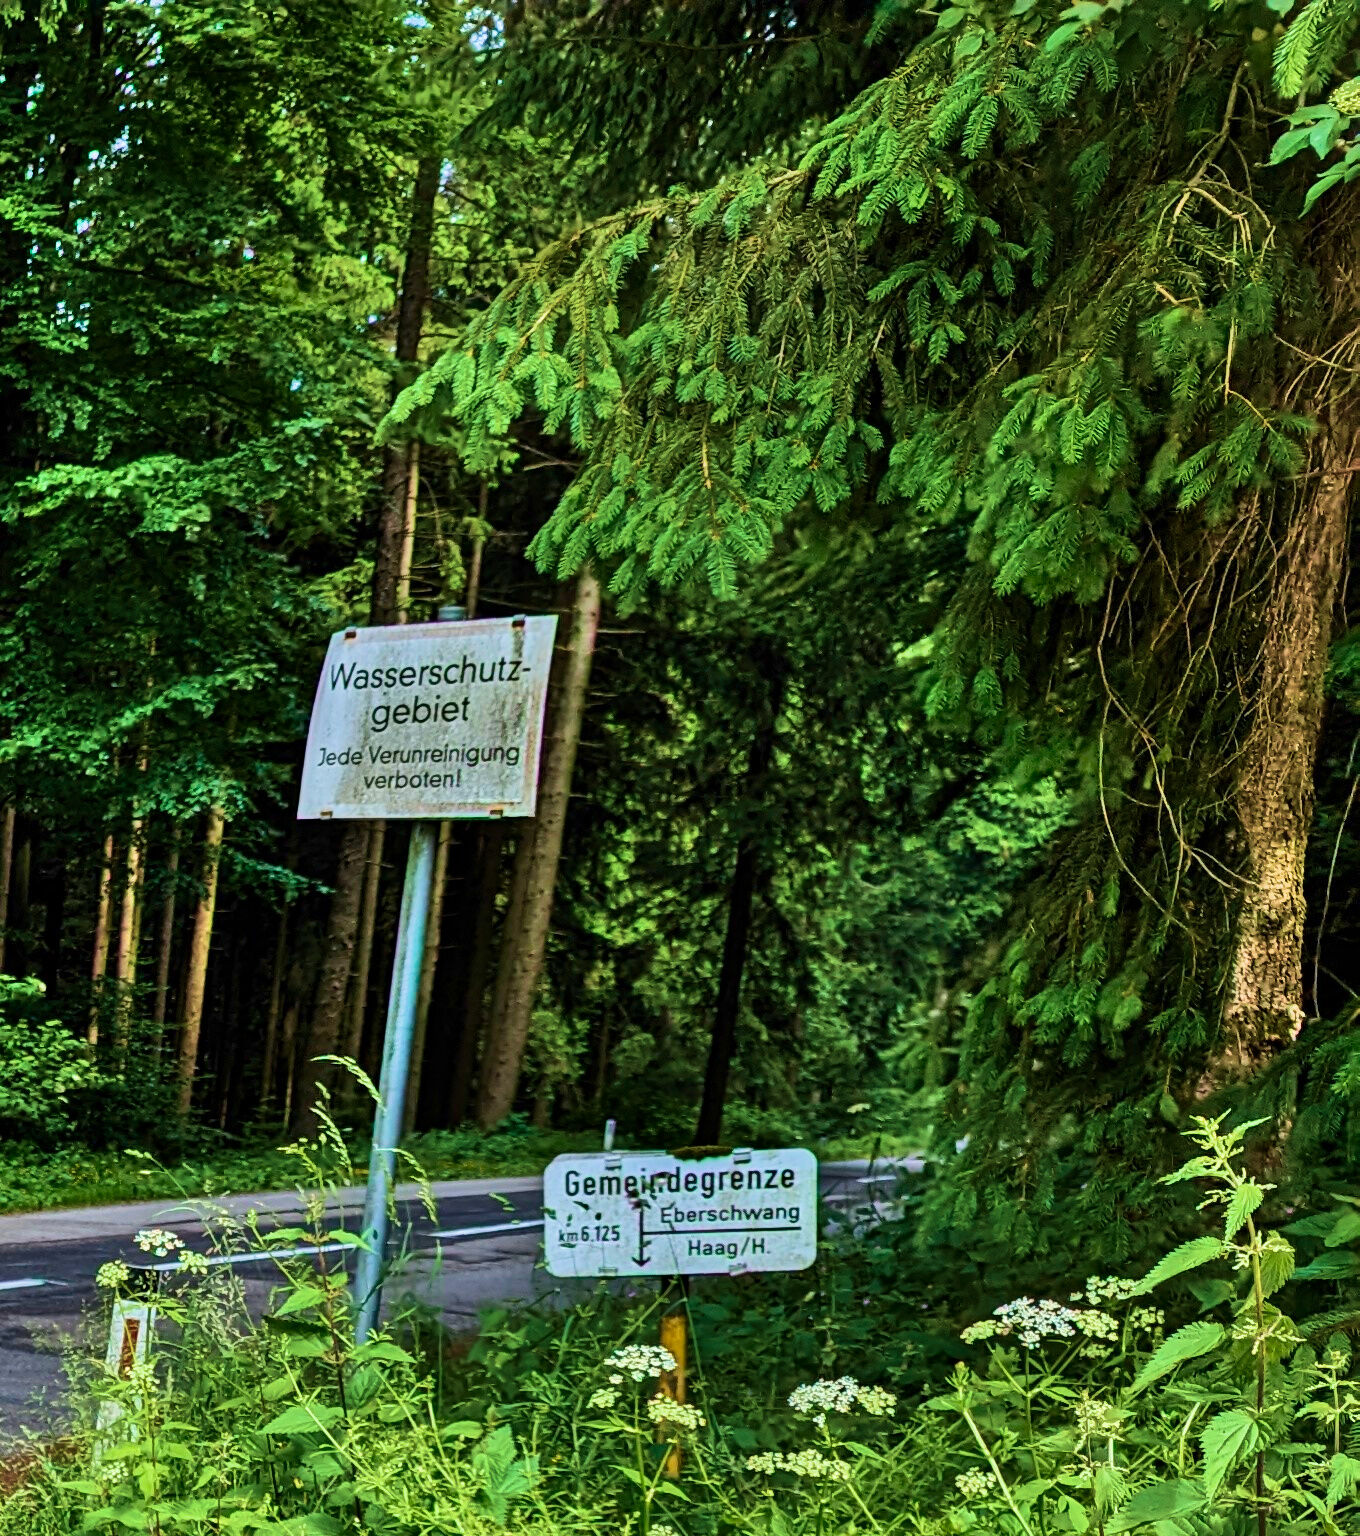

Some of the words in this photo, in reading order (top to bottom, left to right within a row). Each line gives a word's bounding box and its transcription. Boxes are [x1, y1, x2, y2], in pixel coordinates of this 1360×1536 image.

[330, 655, 531, 691] Wasserschutz-
[371, 695, 471, 732] gebiet
[317, 746, 363, 767] Jede
[369, 744, 520, 767] Verunreinigung
[364, 769, 462, 789] verboten!
[660, 1204, 801, 1224] Eberschwang
